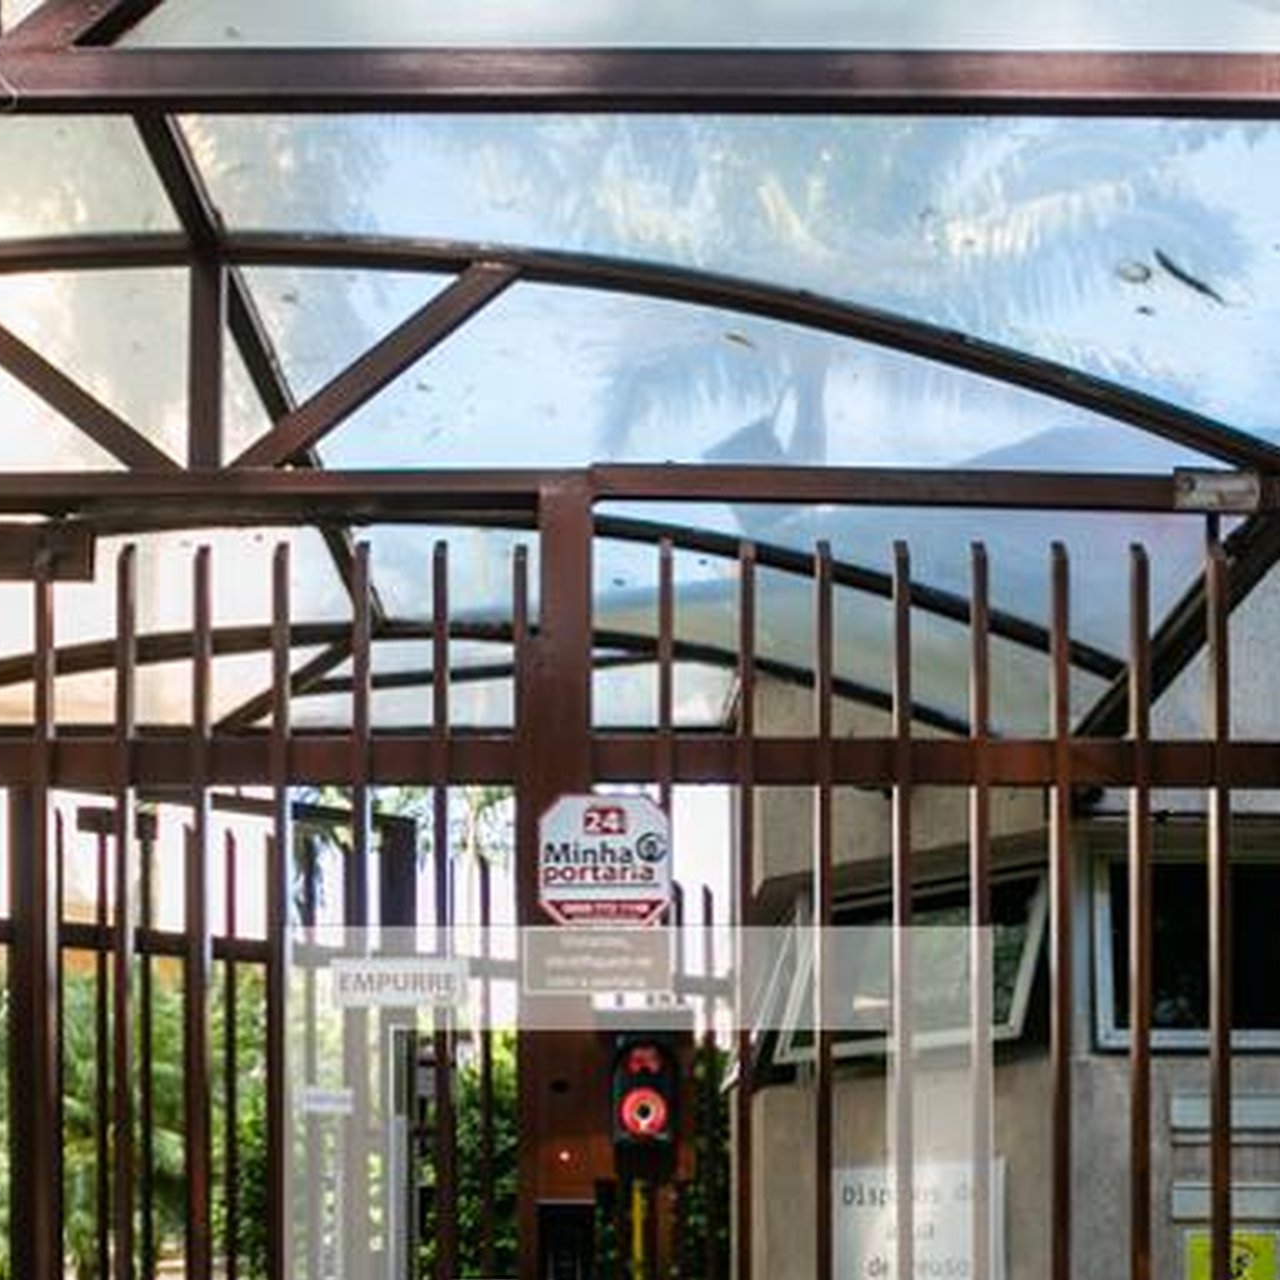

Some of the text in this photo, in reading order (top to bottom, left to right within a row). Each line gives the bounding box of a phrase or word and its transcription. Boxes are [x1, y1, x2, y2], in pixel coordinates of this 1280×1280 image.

[544, 842, 634, 864] Minha
[544, 863, 654, 884] portaria
[339, 972, 458, 993] EMPURRE
